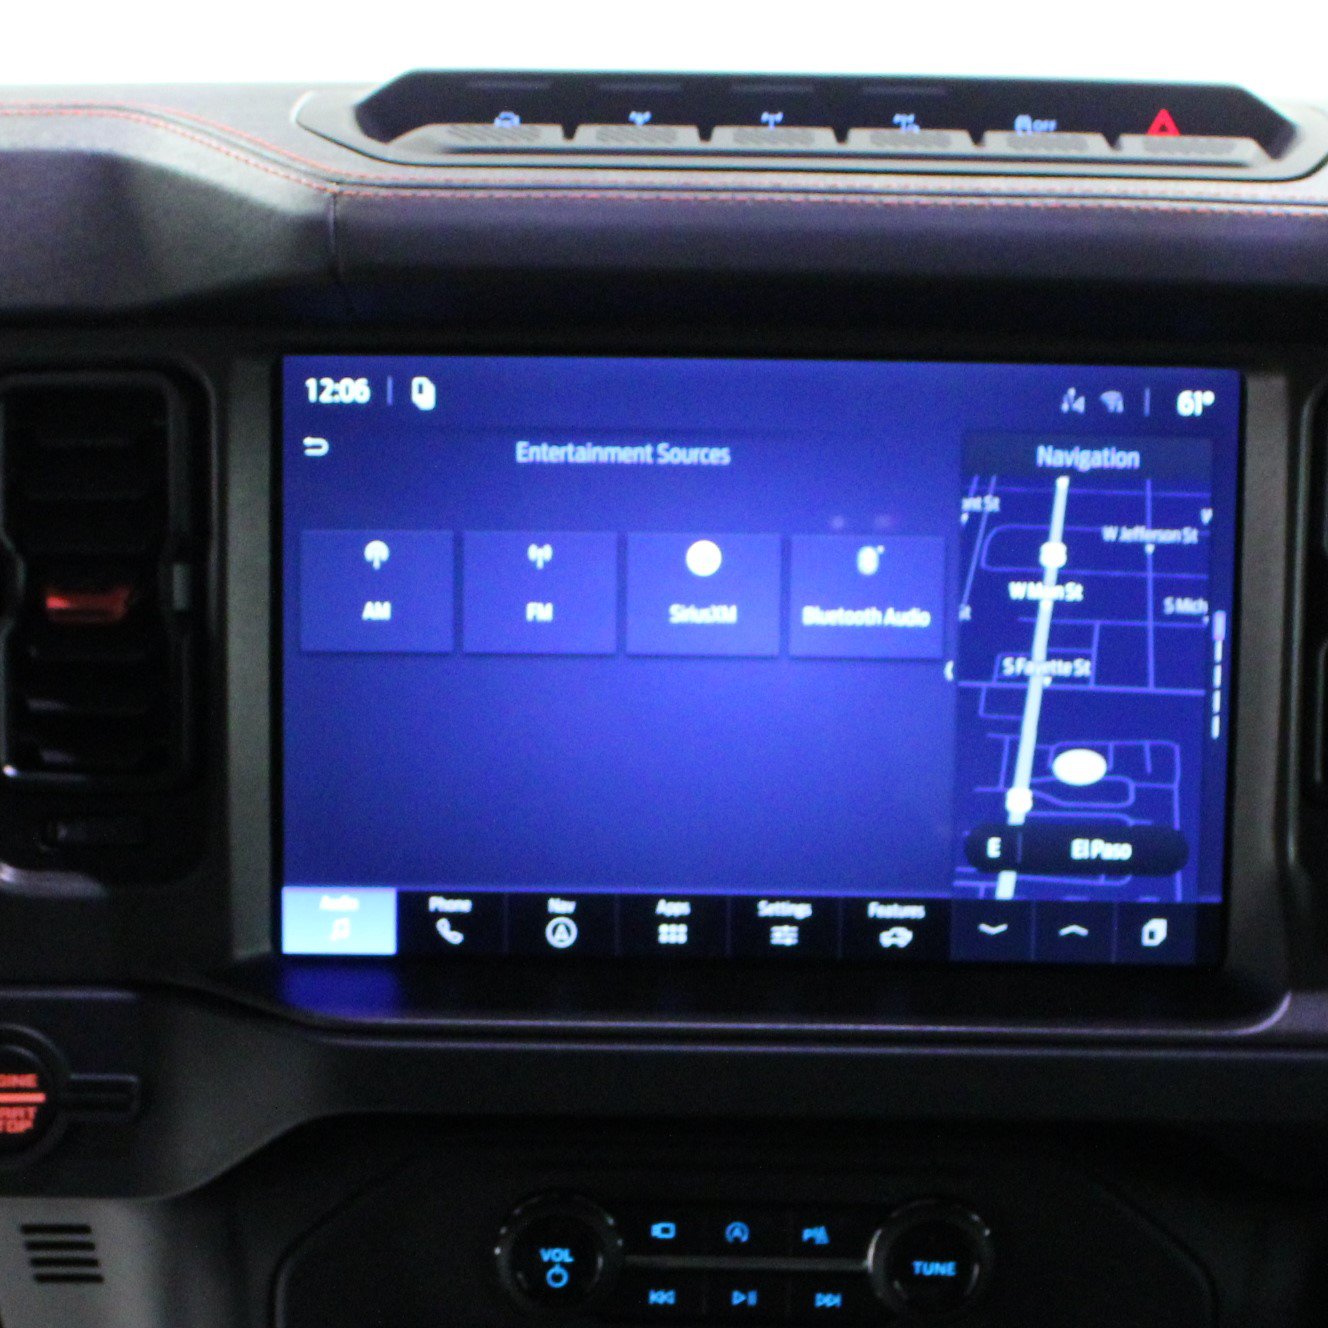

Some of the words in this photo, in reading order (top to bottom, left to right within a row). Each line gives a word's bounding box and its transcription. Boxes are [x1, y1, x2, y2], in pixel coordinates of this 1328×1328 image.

[305, 377, 370, 403] 12:06
[516, 440, 652, 463] Entertainment
[657, 442, 731, 466] Sources
[1036, 445, 1140, 472] Navigation
[362, 602, 391, 621] AM
[526, 602, 553, 622] FM
[669, 604, 737, 624] SiriusXM
[802, 605, 882, 626] Bluetooth
[883, 607, 931, 628] Audio
[1071, 838, 1089, 859] El
[1091, 839, 1132, 860] Paso
[539, 1248, 574, 1263] VOL
[912, 1260, 957, 1277] TUNE
